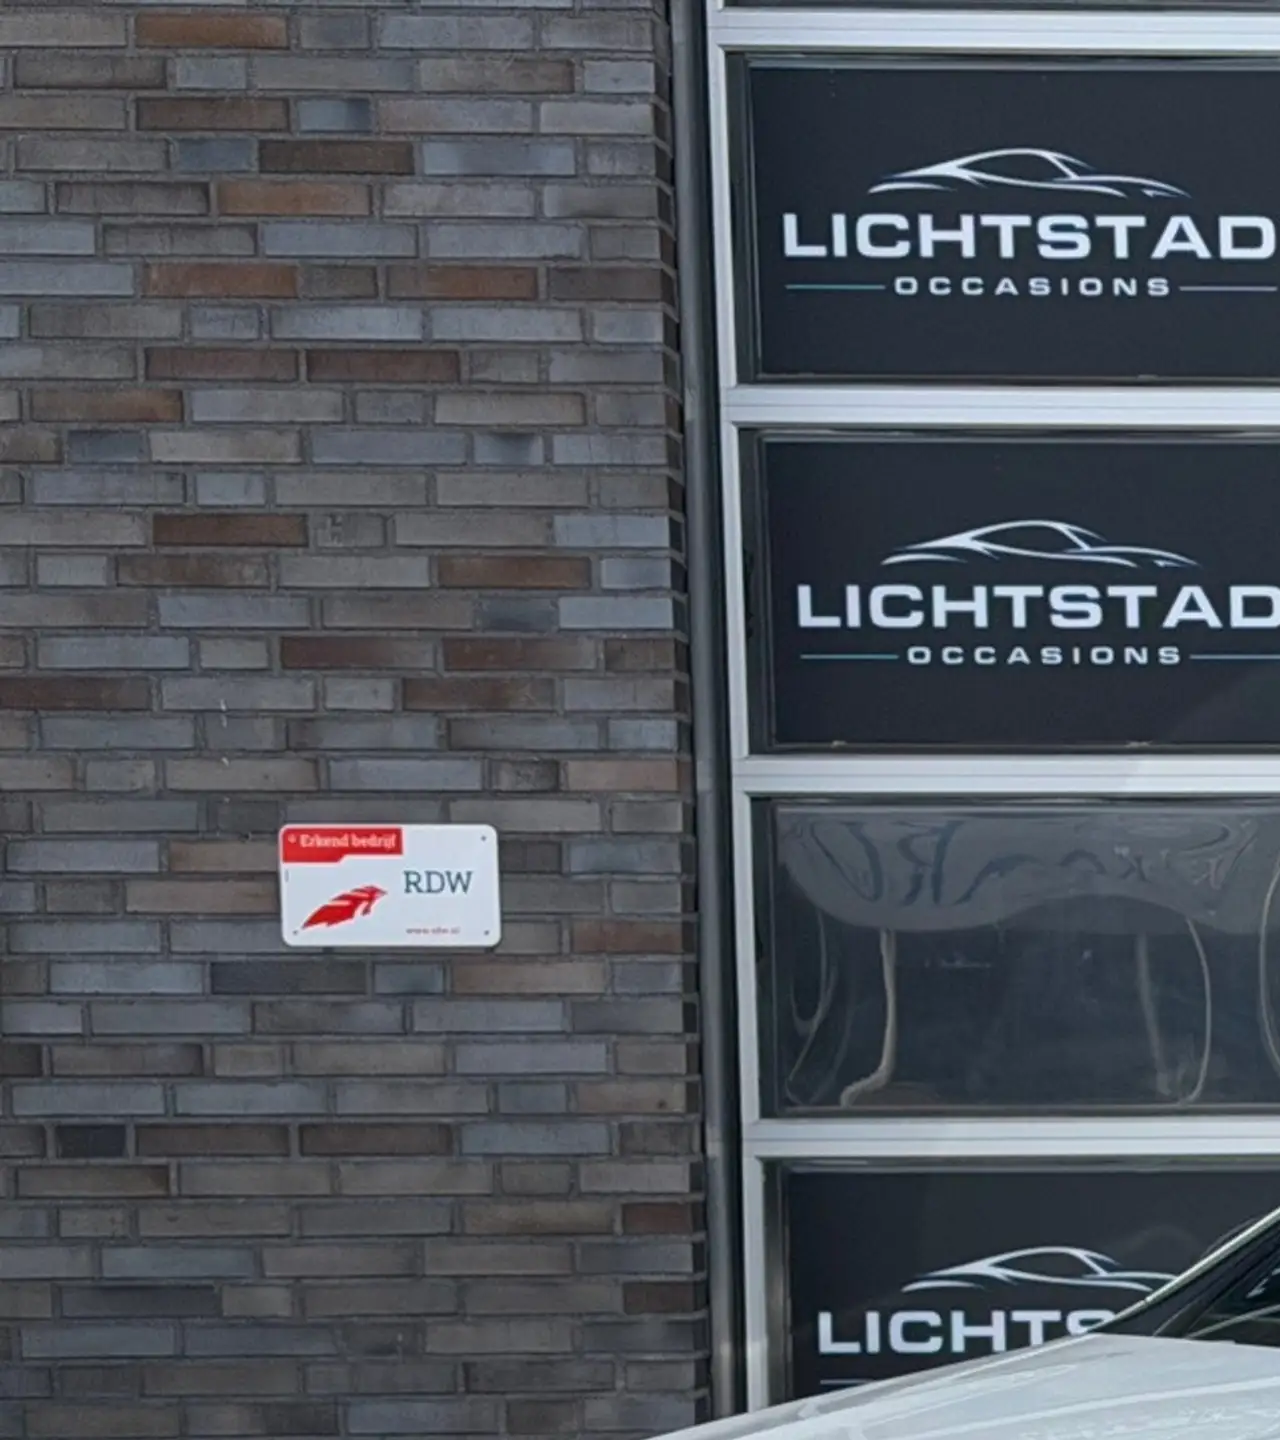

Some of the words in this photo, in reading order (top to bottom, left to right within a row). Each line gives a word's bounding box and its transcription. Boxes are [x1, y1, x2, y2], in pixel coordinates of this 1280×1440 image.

[783, 213, 1277, 260] LICHTSTAD
[894, 276, 1170, 297] OCCASIONS
[907, 646, 1181, 666] OCCASIONS
[300, 833, 349, 848] Erkend
[403, 870, 472, 895] RDW
